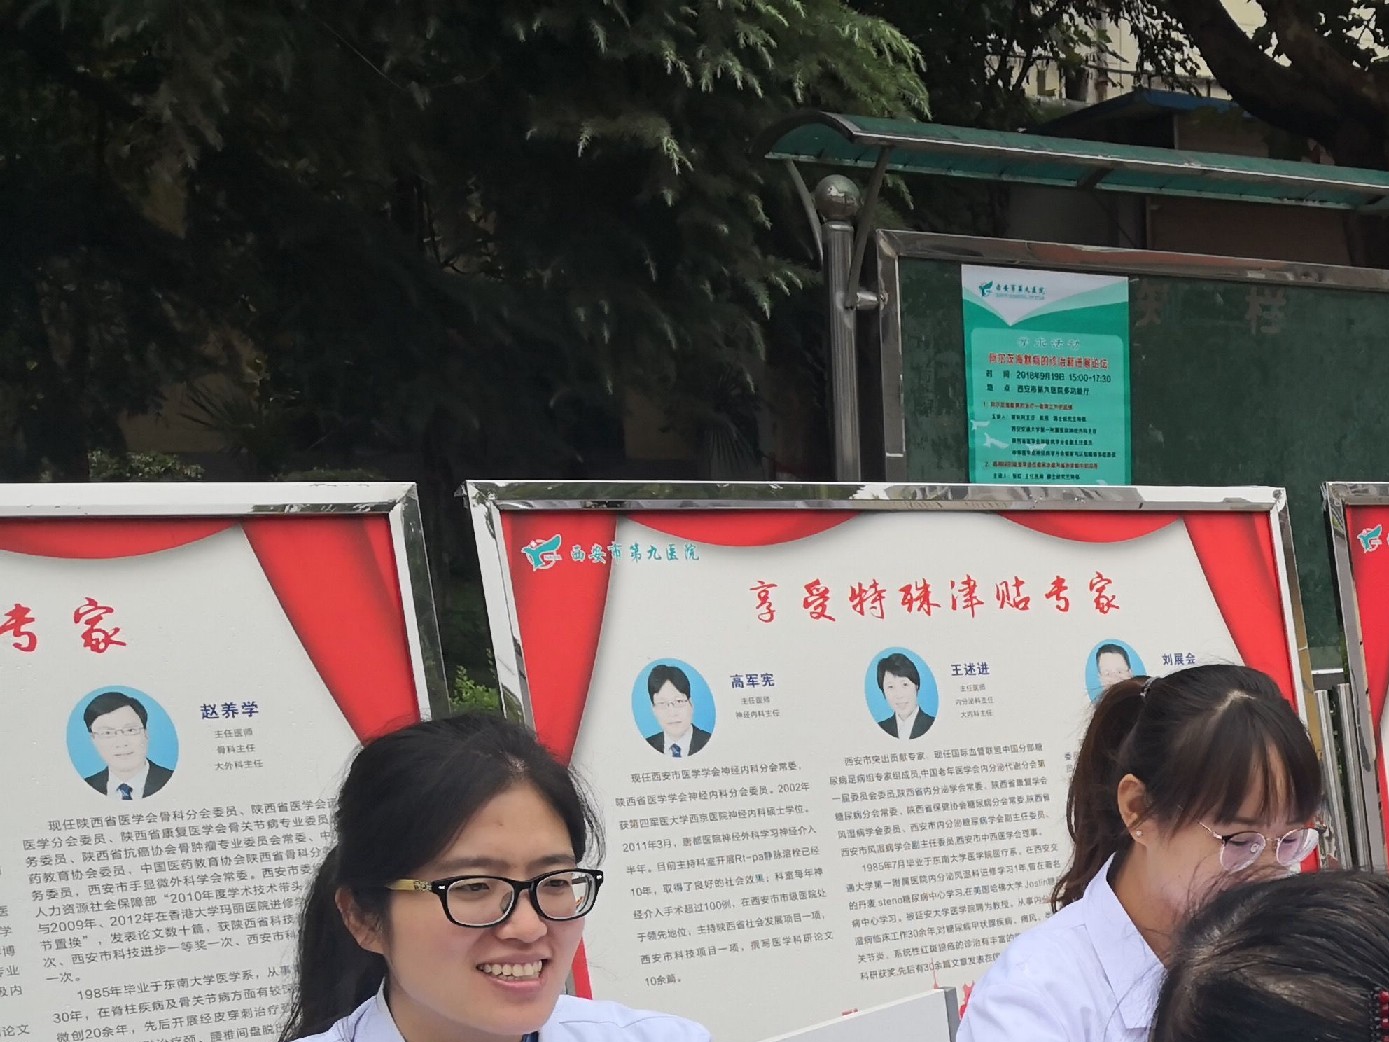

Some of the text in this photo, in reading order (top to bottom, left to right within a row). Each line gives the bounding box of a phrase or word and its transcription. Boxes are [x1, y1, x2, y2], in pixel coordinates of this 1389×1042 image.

[570, 542, 700, 564] 西安市第九医院
[750, 571, 1120, 622] 享受特殊津贴专家
[0, 597, 127, 653] 专家
[200, 701, 259, 720] 赵养学
